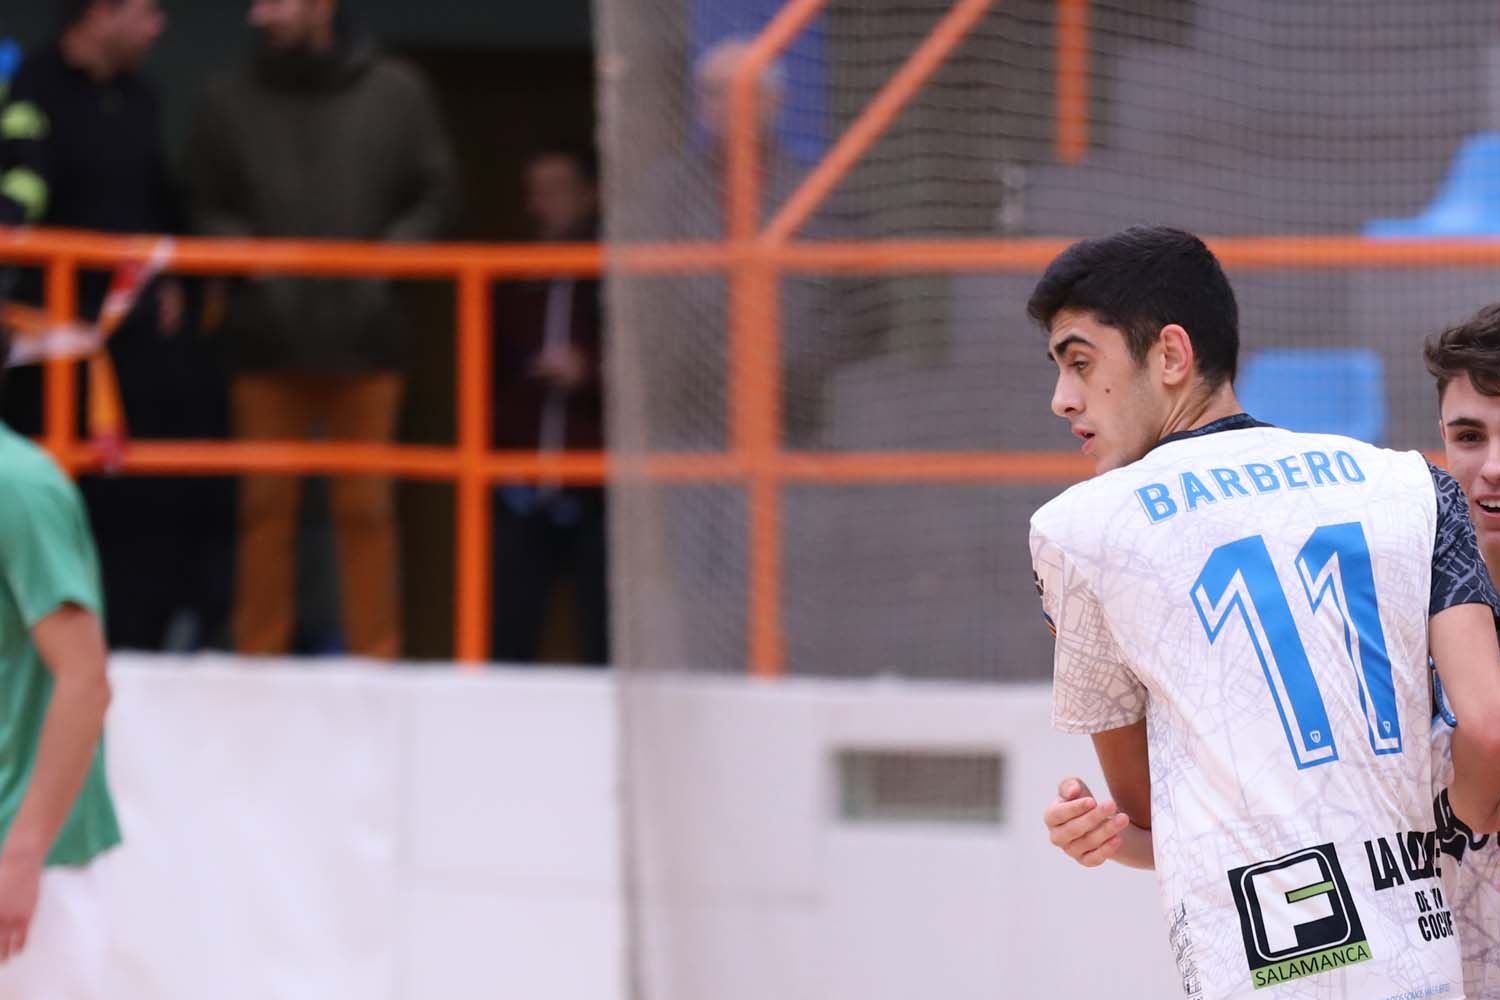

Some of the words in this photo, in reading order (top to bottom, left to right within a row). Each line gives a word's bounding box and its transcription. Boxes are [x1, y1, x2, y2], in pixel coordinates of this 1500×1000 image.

[1135, 450, 1367, 525] BARBERO
[1189, 521, 1404, 771] 11
[1364, 837, 1405, 891] LA
[1415, 890, 1432, 913] DE
[1255, 945, 1368, 987] SALAMANCA
